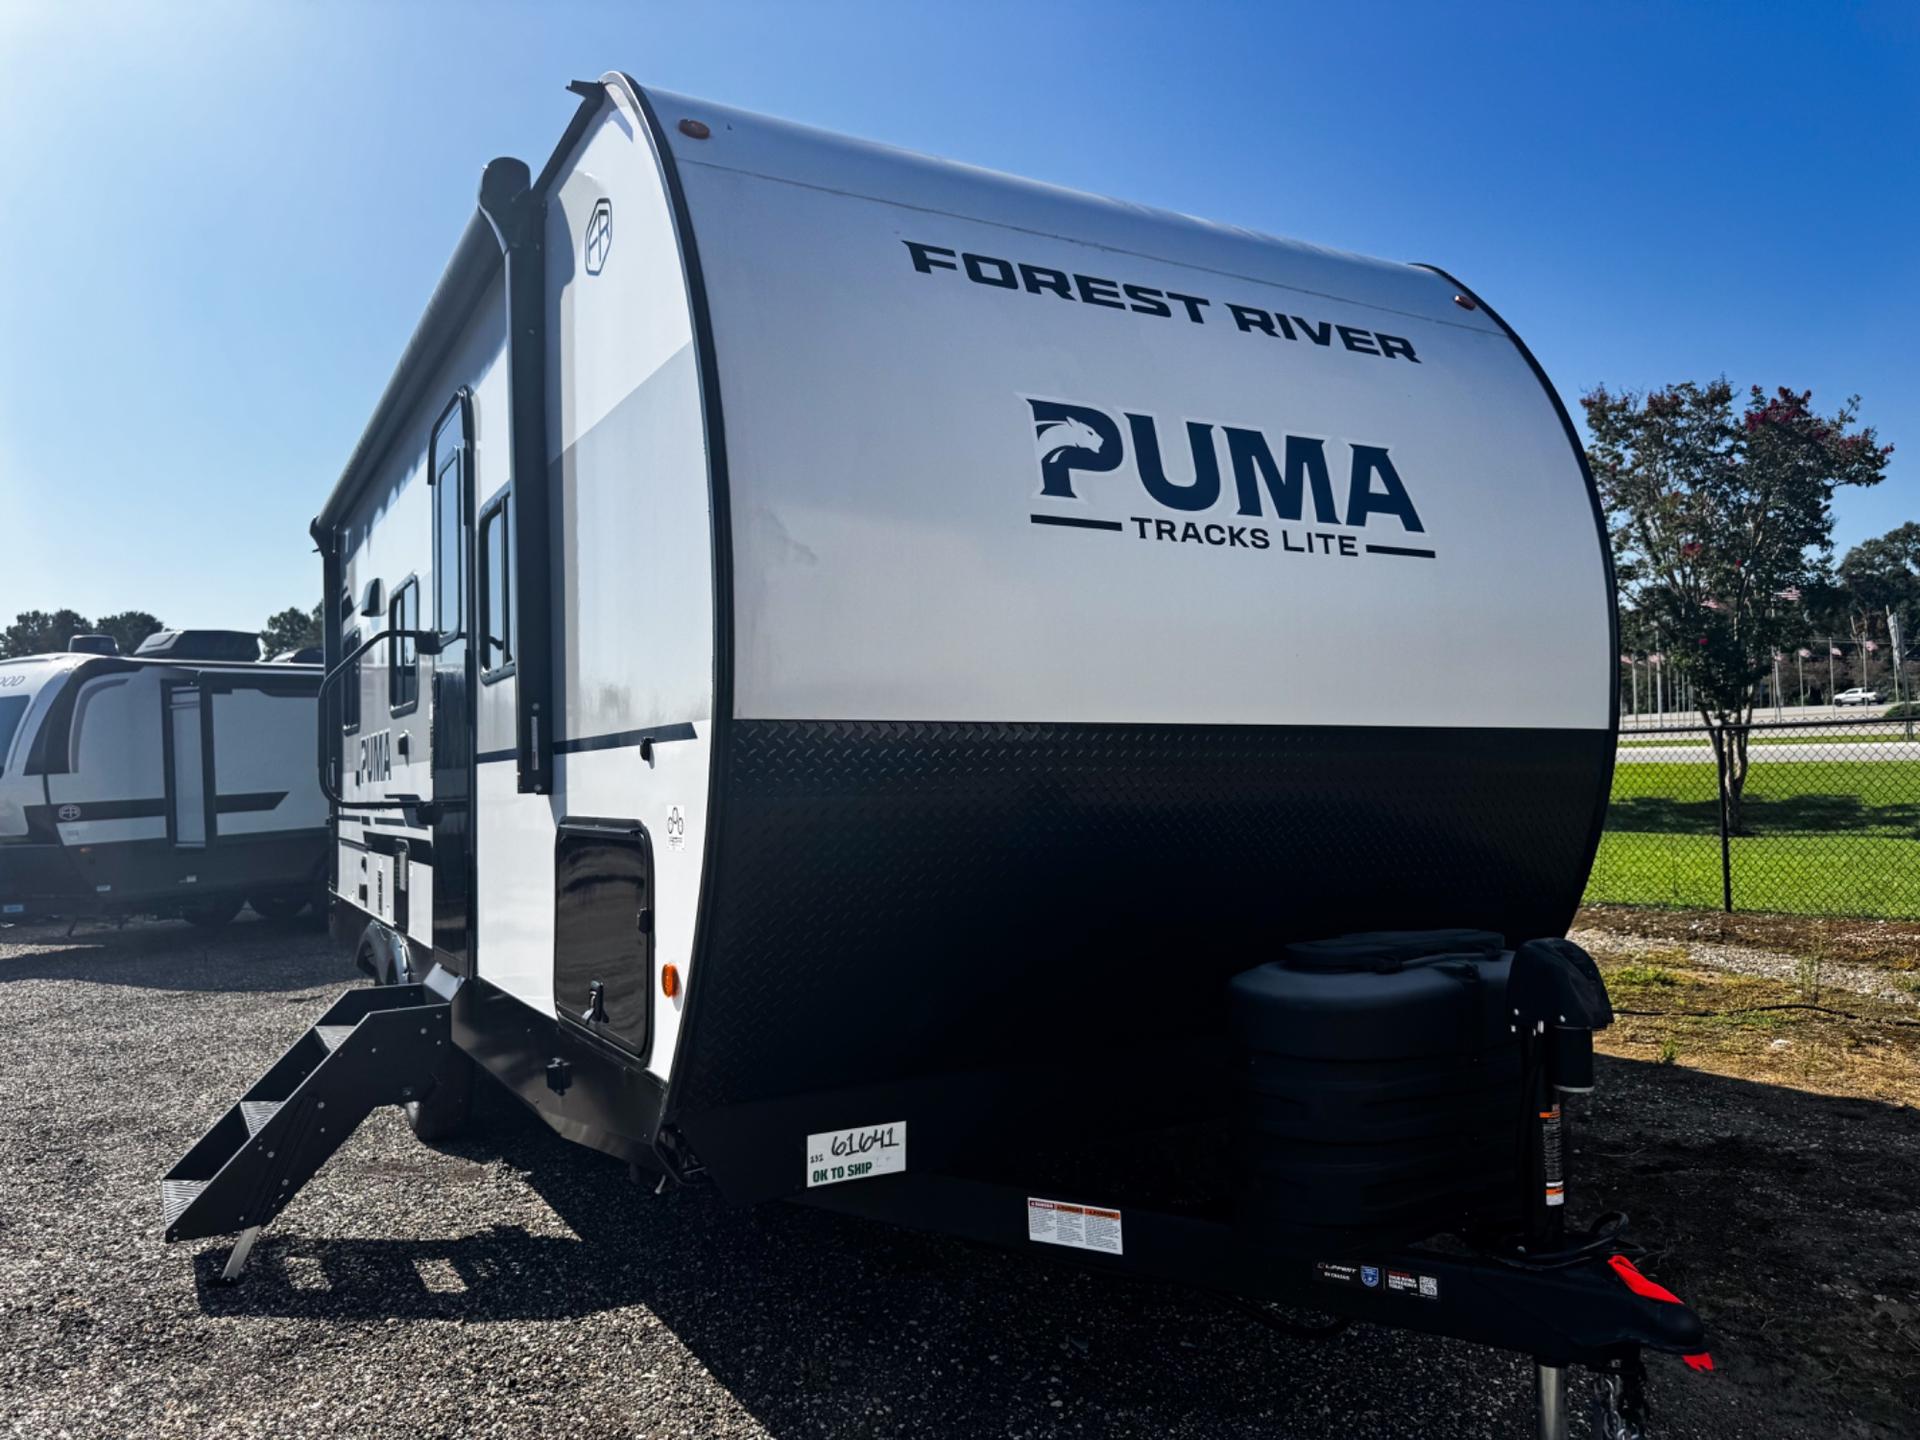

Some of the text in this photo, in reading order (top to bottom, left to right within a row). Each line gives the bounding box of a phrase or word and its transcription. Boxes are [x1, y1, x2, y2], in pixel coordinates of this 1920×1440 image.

[902, 240, 1422, 364] FOREST RIVER
[1024, 397, 1425, 534] PUMA
[1130, 516, 1358, 557] TRACKS LITE
[361, 731, 391, 783] PUMA
[831, 1127, 900, 1156] 61641
[813, 1162, 873, 1183] OK TO SHIP
